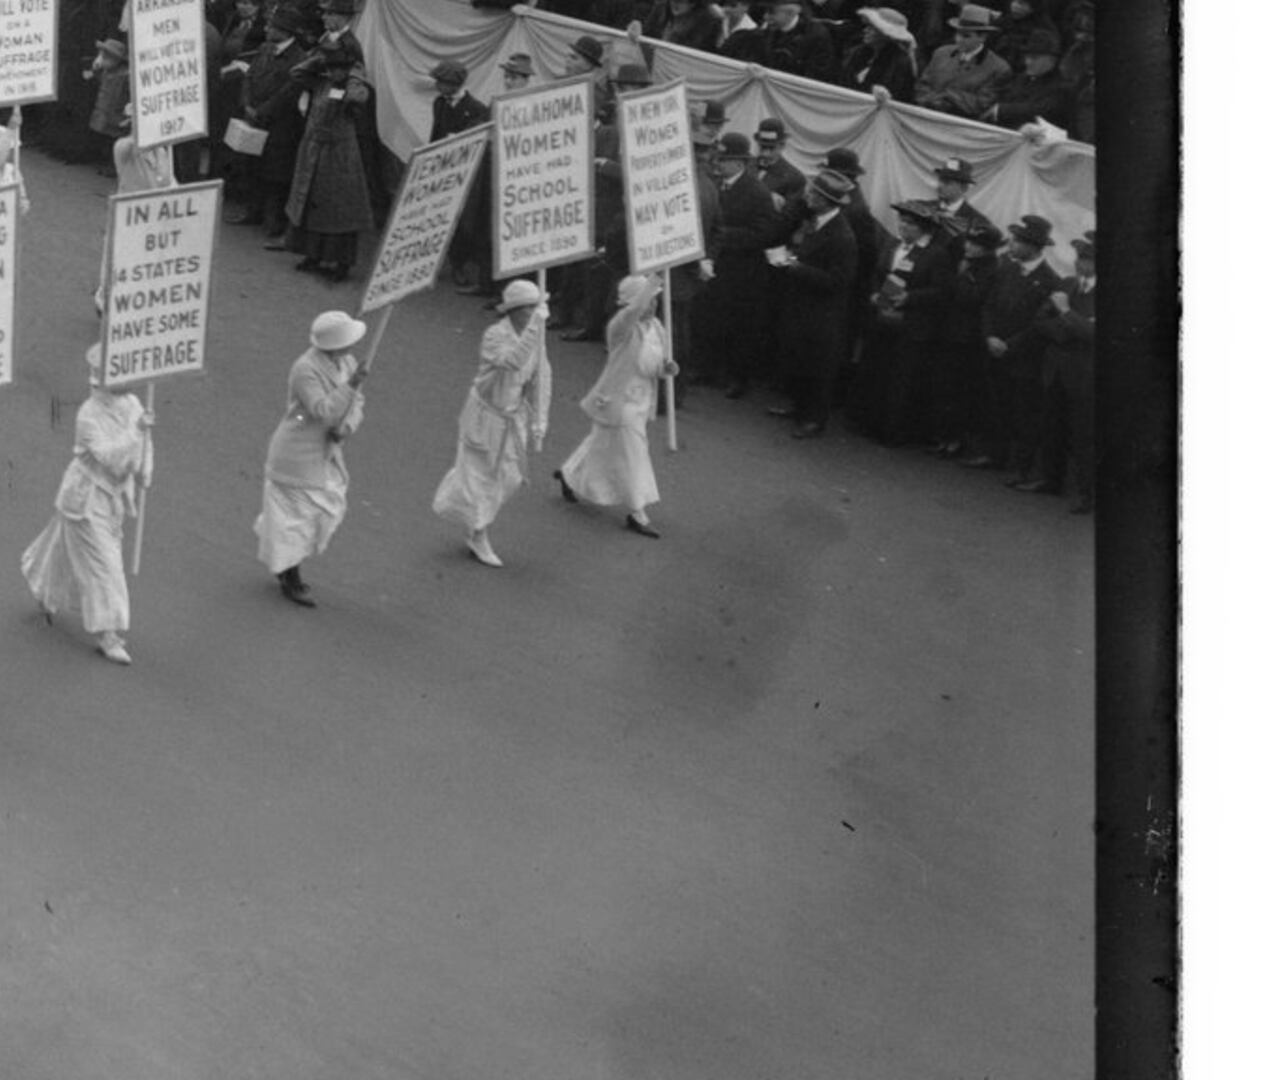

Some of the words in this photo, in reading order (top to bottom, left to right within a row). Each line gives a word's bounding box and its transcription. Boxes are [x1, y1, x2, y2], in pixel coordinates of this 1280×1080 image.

[153, 19, 180, 37] MEN
[141, 59, 199, 88] WOMAN
[141, 84, 199, 116] SUFFRAGE
[501, 94, 584, 131] OKLAHOMA
[504, 127, 578, 159] WOMEN
[634, 121, 680, 145] WOMEN
[507, 162, 542, 179] HAVE
[546, 155, 572, 171] HAD
[404, 172, 468, 206] WOMEN
[503, 176, 579, 208] SCHOOL
[126, 204, 150, 227] IN
[158, 198, 199, 221] ALL
[503, 201, 584, 241] SUFFRAGE
[145, 230, 183, 252] BUT
[132, 254, 201, 282] STATES
[115, 282, 202, 313] WOMEN
[111, 316, 155, 341] HAVE
[158, 308, 202, 333] SOME
[109, 340, 199, 378] SUFFRAGE
